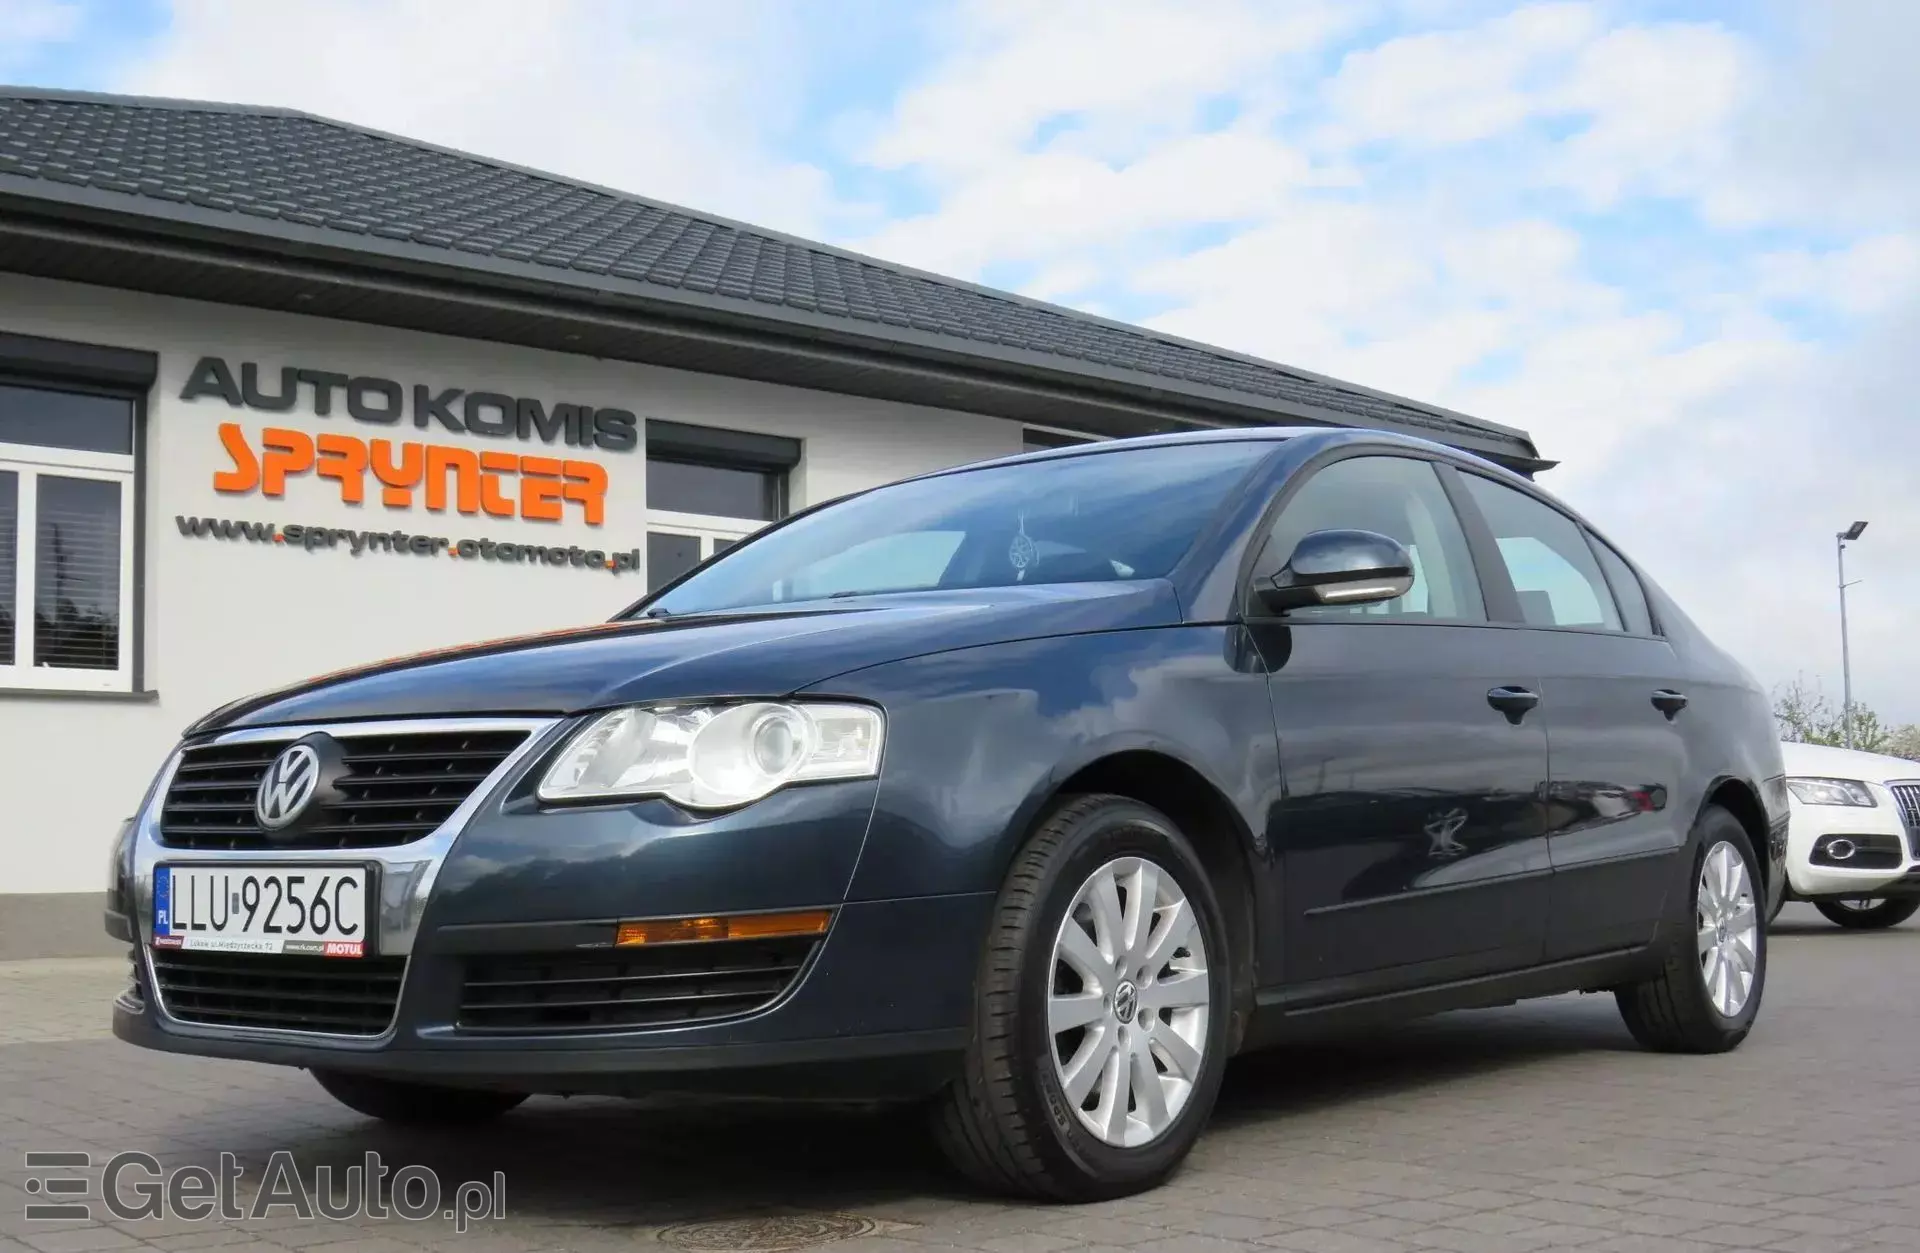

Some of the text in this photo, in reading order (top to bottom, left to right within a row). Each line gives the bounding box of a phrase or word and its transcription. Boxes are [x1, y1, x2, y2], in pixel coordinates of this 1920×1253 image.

[180, 356, 638, 452] AUTO KOMIS
[213, 423, 609, 526] SPRYNTER
[175, 515, 641, 577] www.sprynter.otomoto.pl
[158, 910, 169, 925] PL
[172, 874, 358, 936] LLU 9256C
[327, 942, 363, 955] MOTUL
